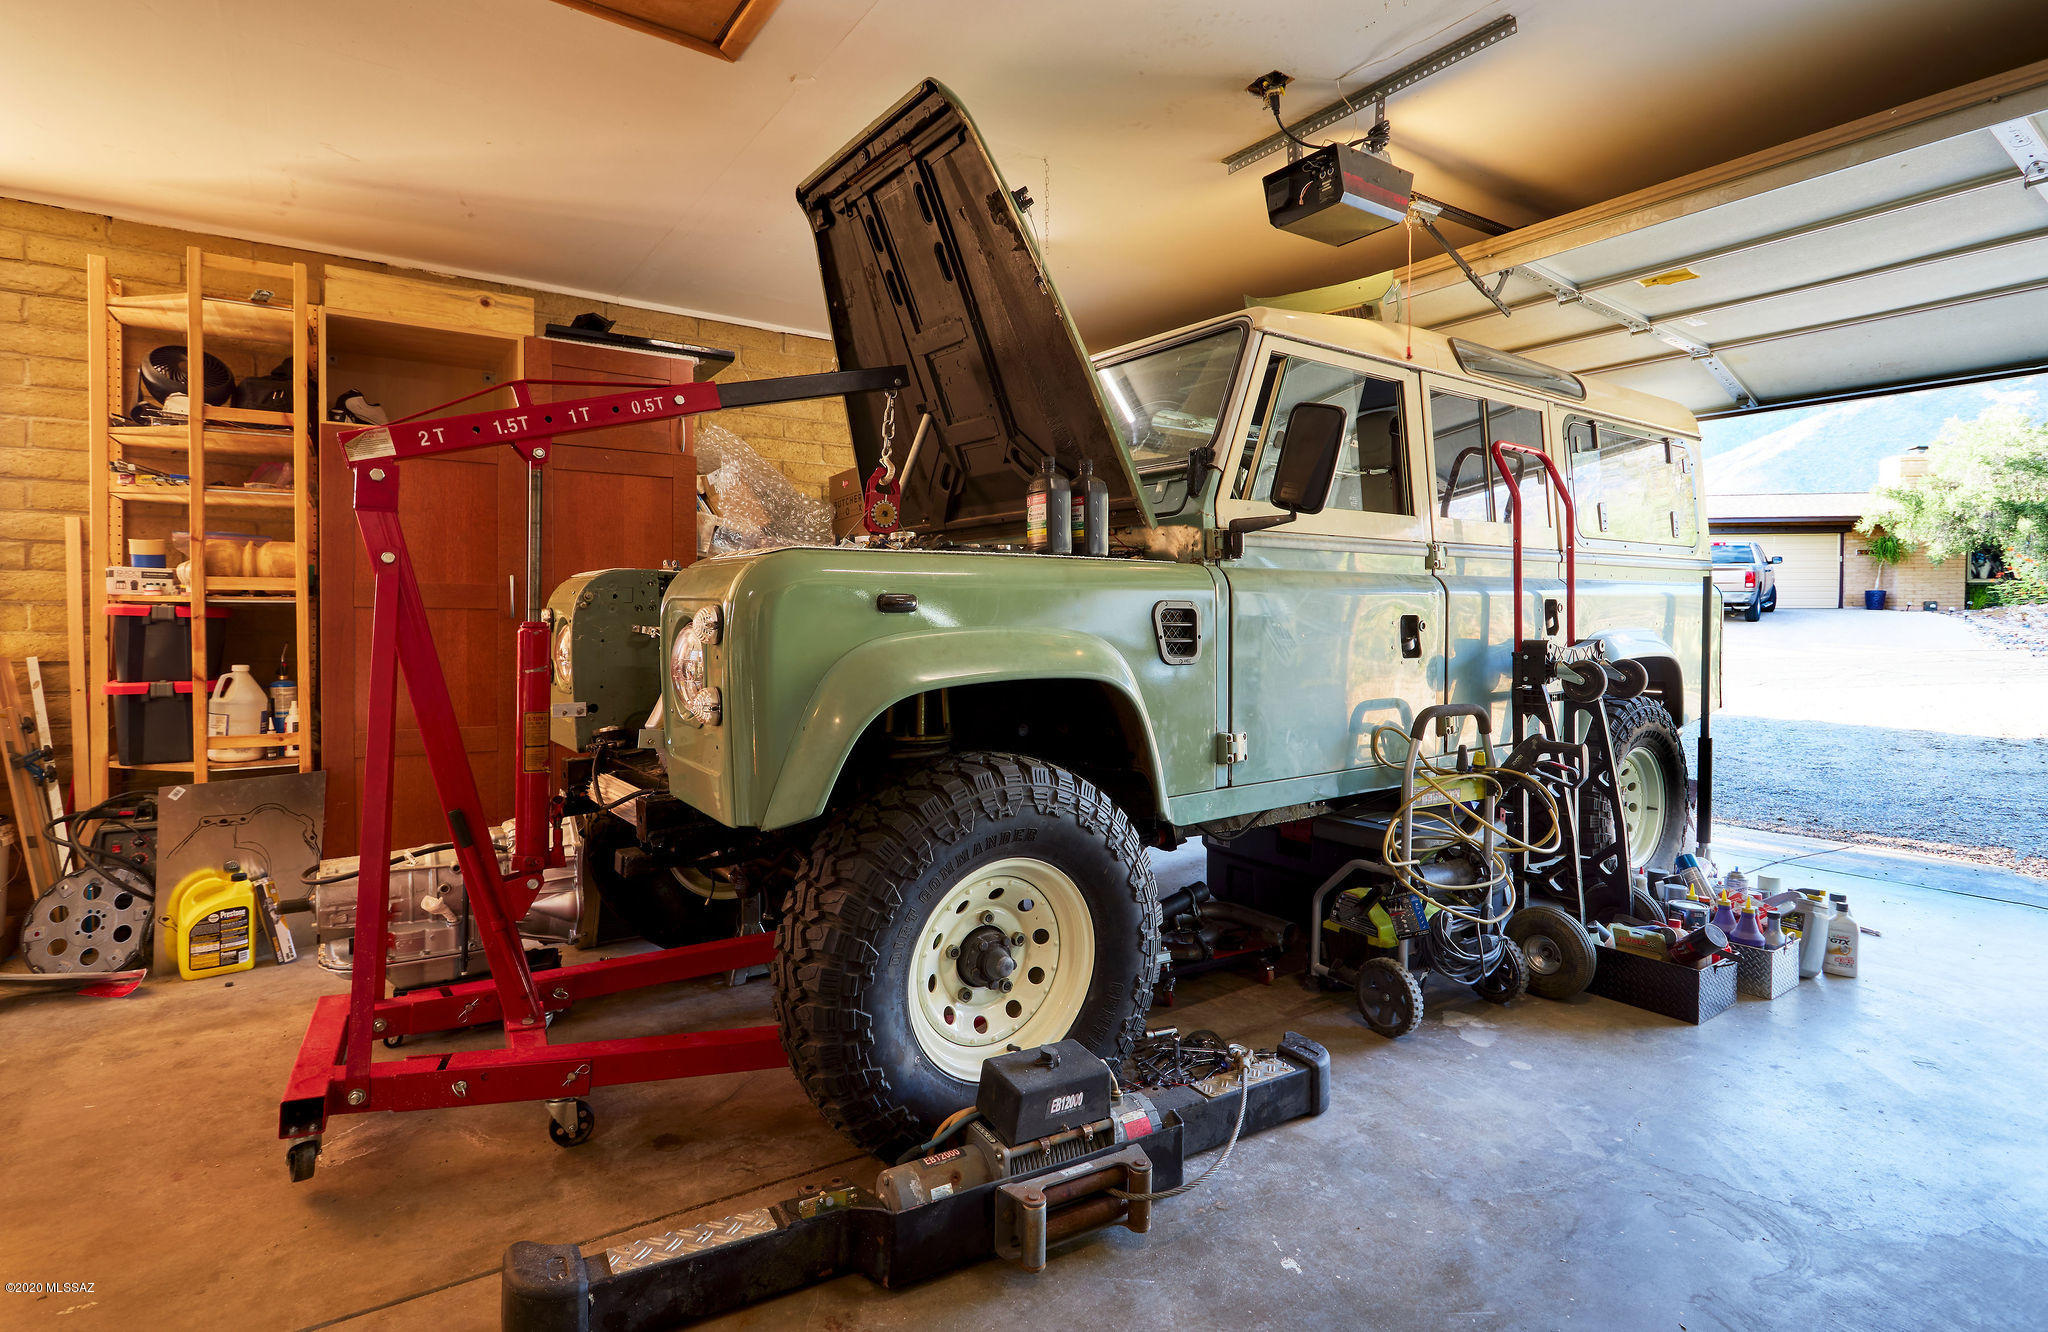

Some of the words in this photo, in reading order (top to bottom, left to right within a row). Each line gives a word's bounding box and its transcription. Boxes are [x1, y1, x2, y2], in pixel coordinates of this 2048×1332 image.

[418, 428, 444, 446] 2T
[493, 415, 529, 435] 1.5T
[568, 407, 589, 424] 1T
[631, 396, 664, 414] 0.5T
[889, 907, 920, 966] DIRT
[918, 828, 1039, 904] COMMANDER
[220, 909, 246, 919] Prestone
[1051, 1092, 1083, 1114] EB12000
[923, 1149, 960, 1165] EB12000
